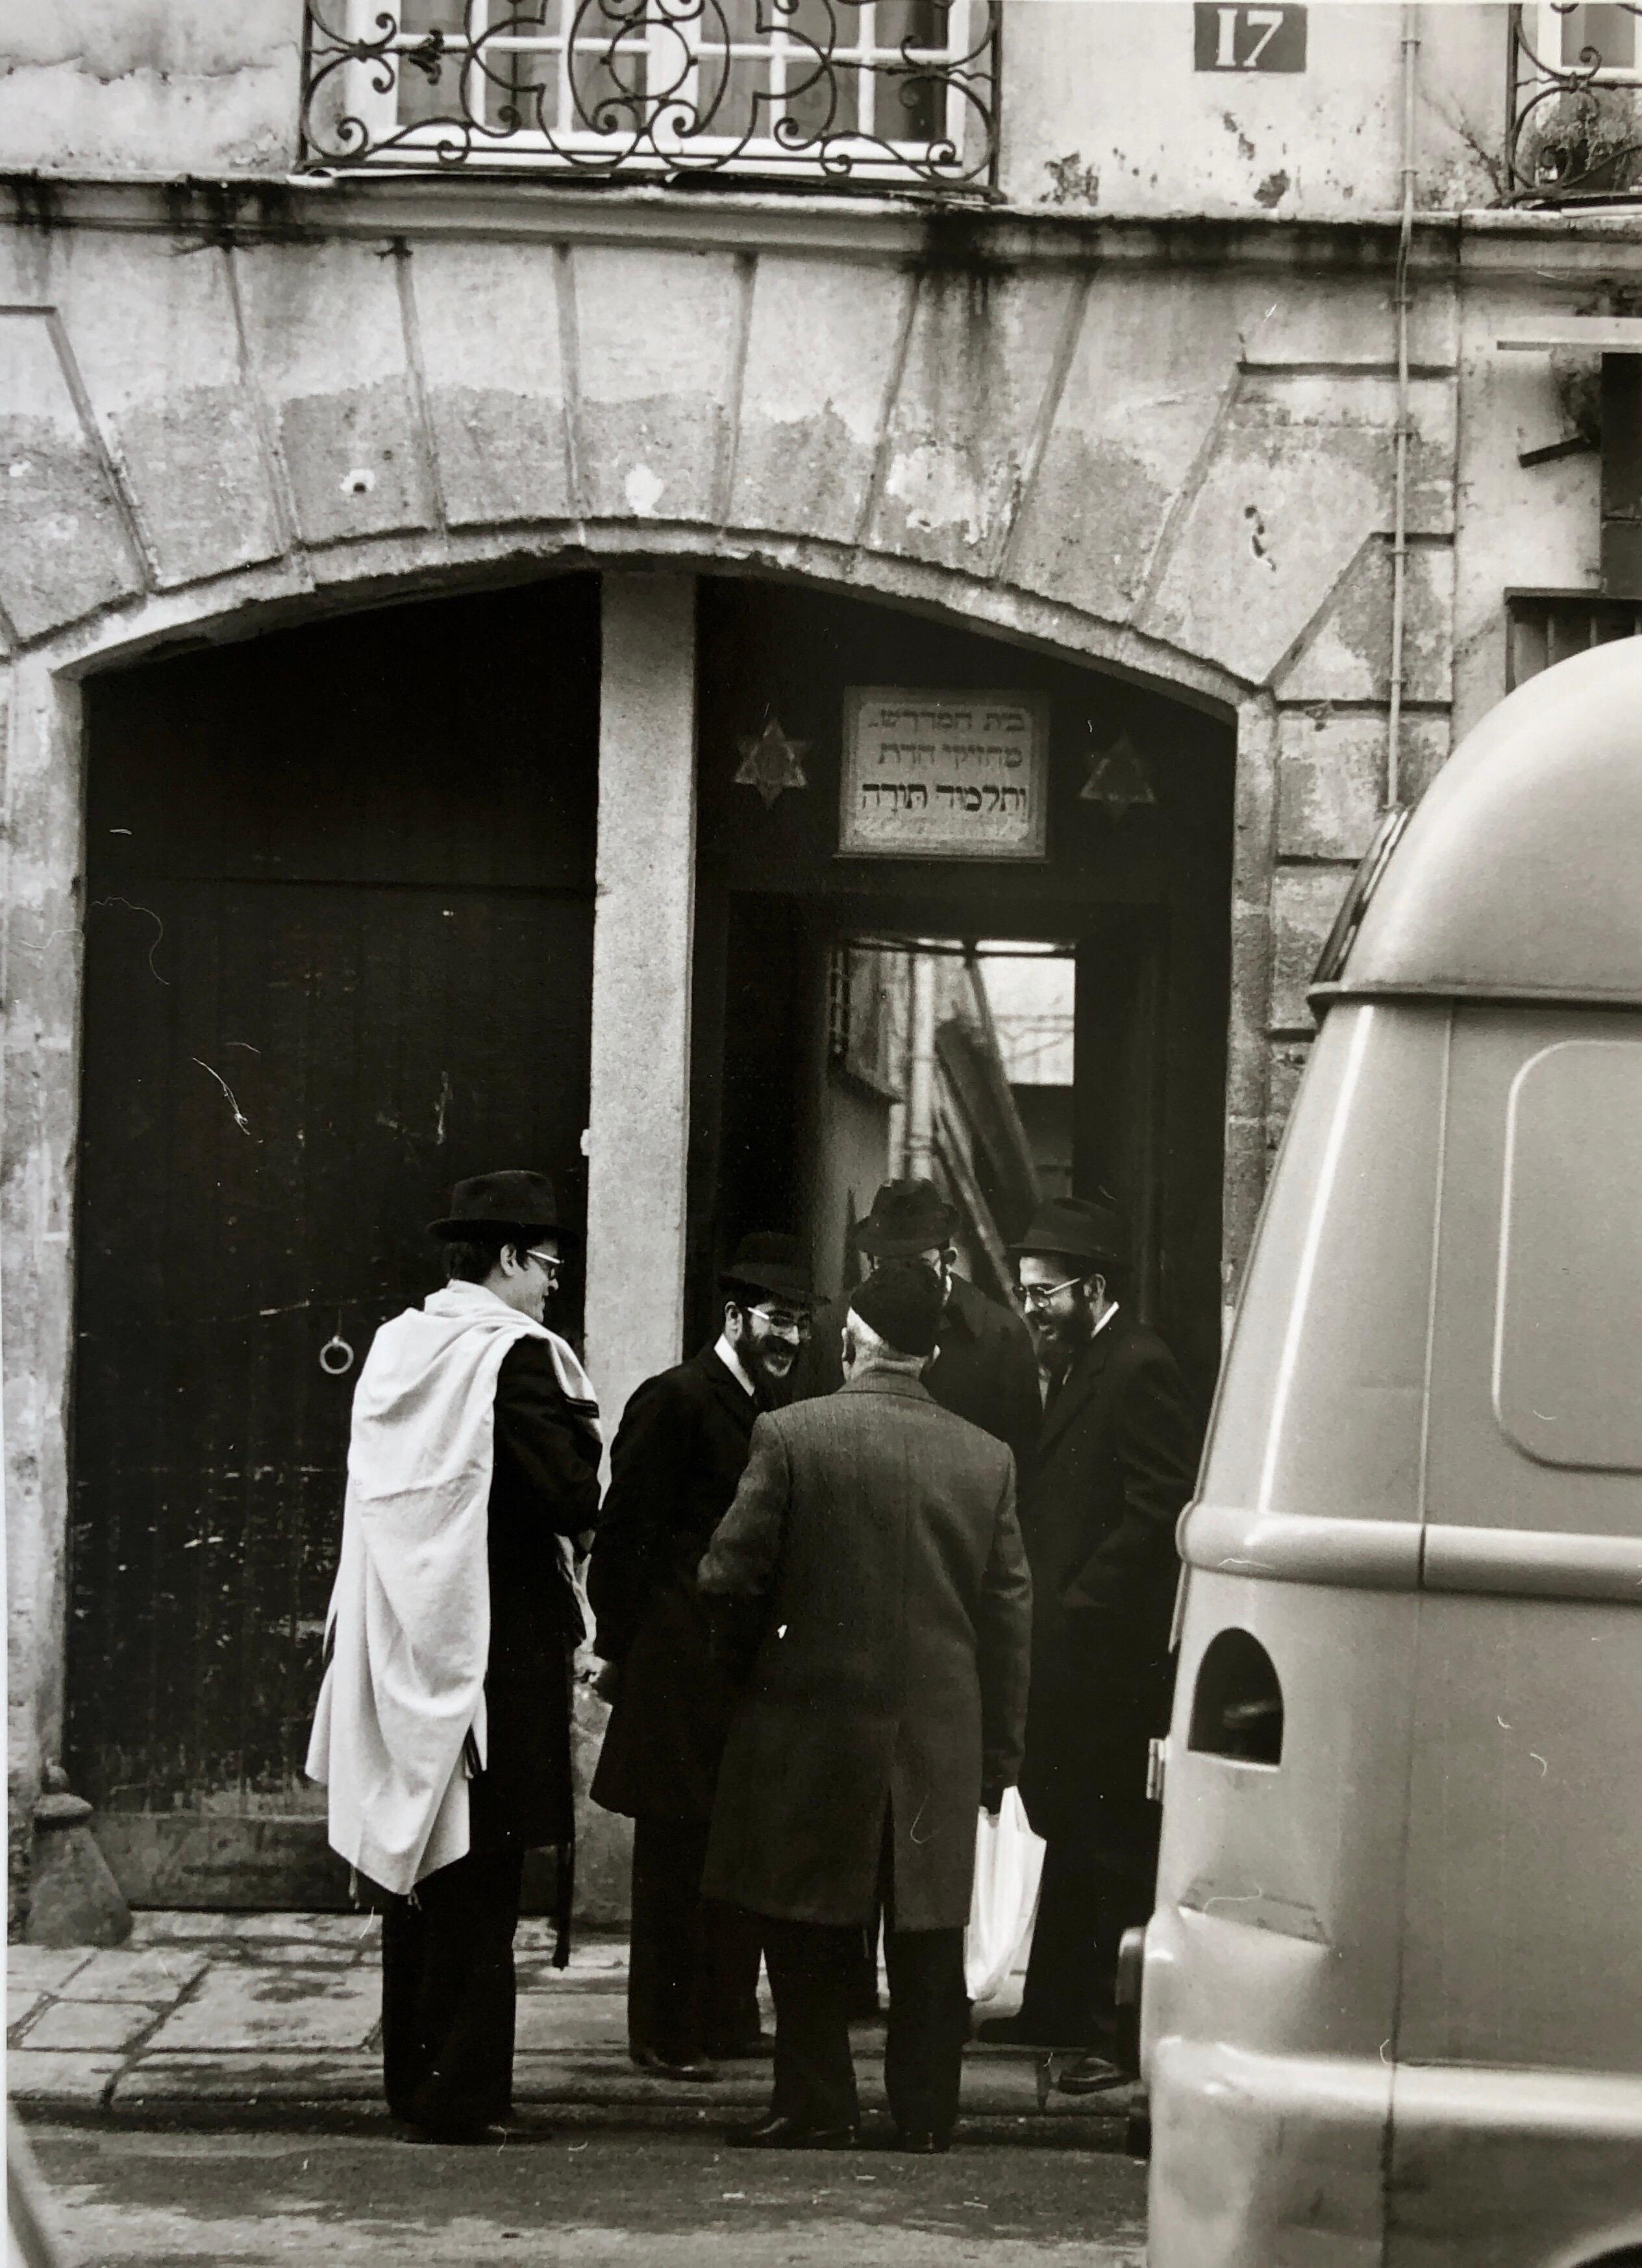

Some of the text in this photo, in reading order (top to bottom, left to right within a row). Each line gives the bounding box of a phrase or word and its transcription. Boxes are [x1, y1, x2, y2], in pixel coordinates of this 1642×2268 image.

[1215, 7, 1284, 68] 17
[983, 712, 1025, 732] בית
[878, 742, 935, 765] הדת
